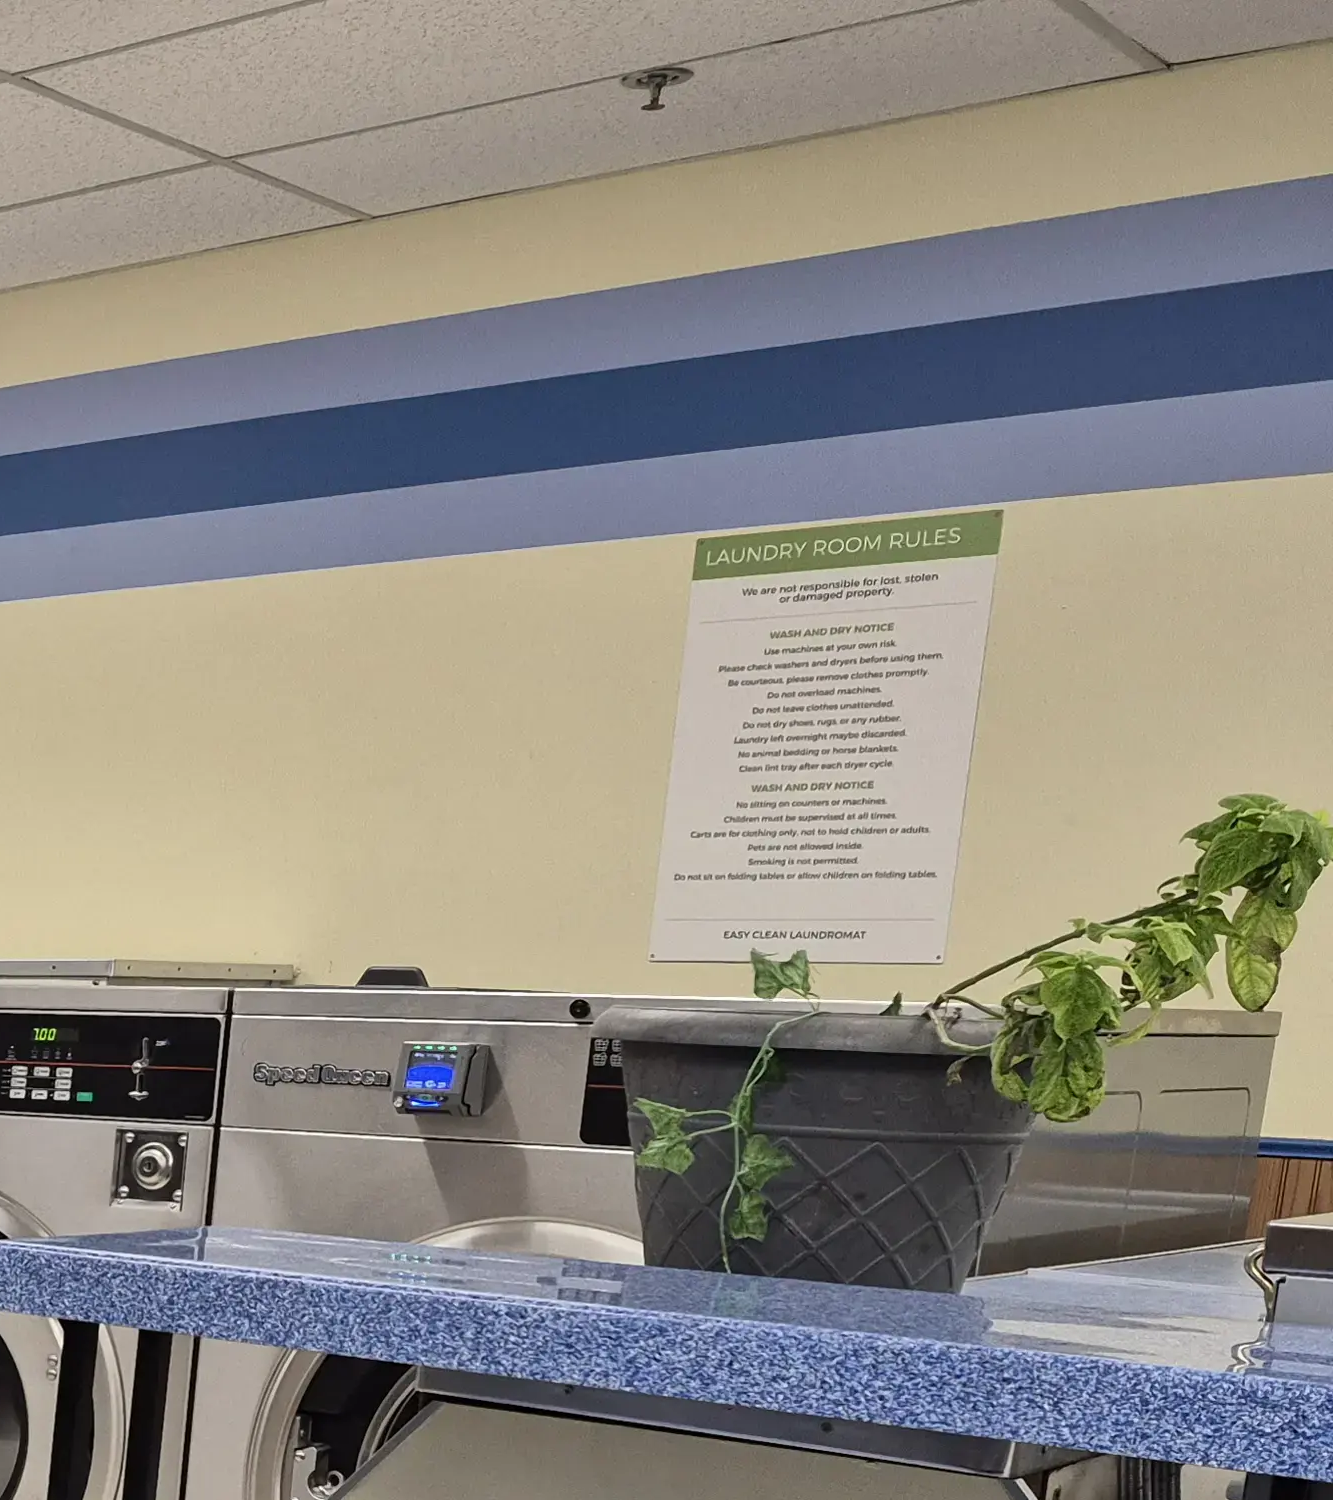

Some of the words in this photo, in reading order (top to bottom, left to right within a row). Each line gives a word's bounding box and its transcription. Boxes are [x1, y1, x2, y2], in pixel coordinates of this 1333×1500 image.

[705, 541, 808, 567] LAUNDRY
[812, 534, 882, 557] ROOM
[889, 527, 961, 550] RULES
[741, 587, 759, 597] We
[759, 586, 778, 596] are
[778, 583, 798, 594] not
[799, 578, 861, 593] responsible
[862, 576, 880, 587] for
[903, 572, 939, 584] stolen
[778, 595, 792, 604] or
[792, 589, 844, 603] damaged
[769, 629, 803, 640] WASH
[802, 627, 829, 638] AND
[829, 624, 853, 636] DRY
[853, 621, 896, 635] NOTICE
[750, 783, 784, 793] WASH
[783, 782, 809, 793] AND
[809, 781, 833, 792] DRY
[833, 779, 875, 791] NOTICE
[722, 930, 751, 940] EASY
[751, 930, 788, 940] CLEAN
[789, 930, 868, 941] LAUNDROMAT
[254, 1062, 321, 1086] Speed
[322, 1063, 391, 1087] Queen
